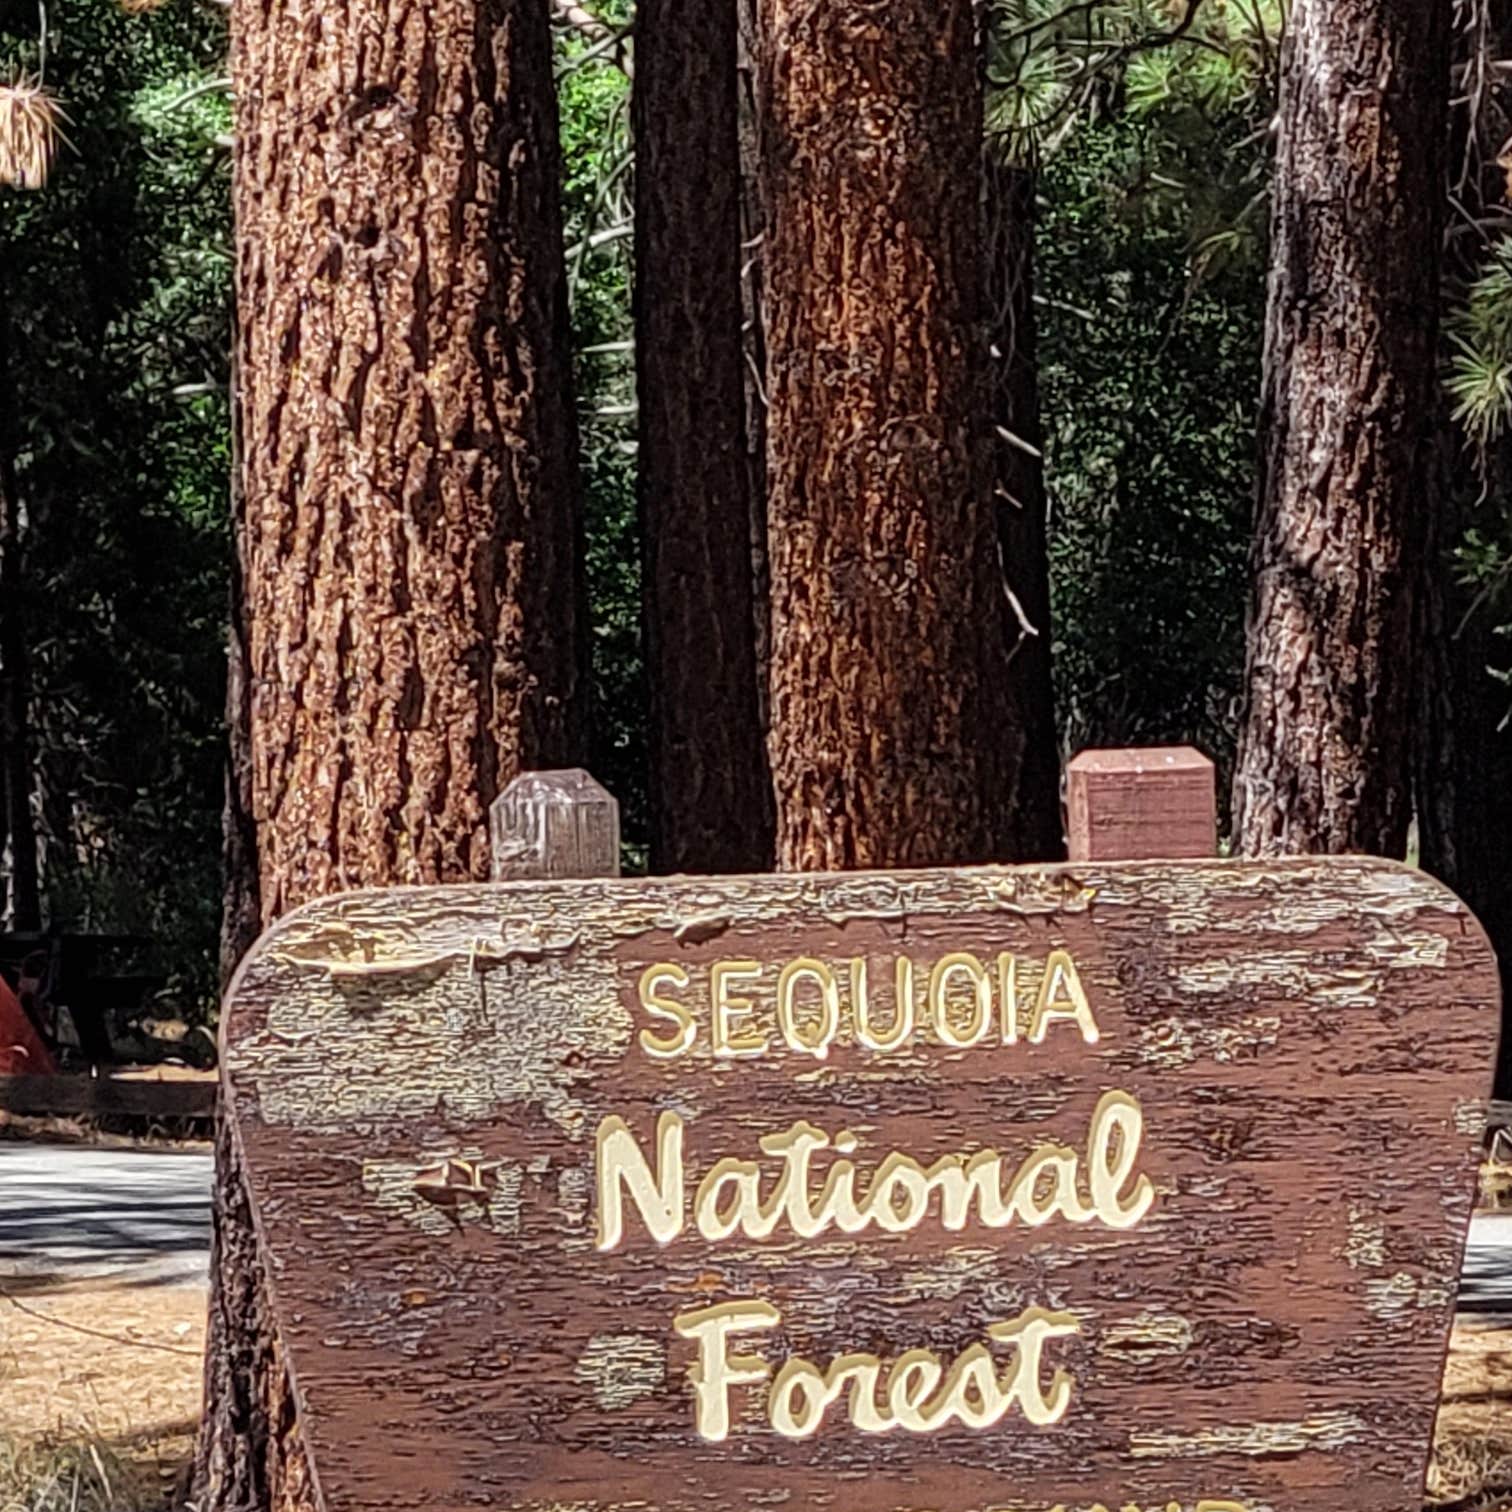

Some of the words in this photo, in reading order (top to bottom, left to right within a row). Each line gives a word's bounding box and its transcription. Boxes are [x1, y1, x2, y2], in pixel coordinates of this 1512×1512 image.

[639, 951, 1098, 1058] SEQUOIA
[598, 1091, 1153, 1249] National
[676, 1302, 1080, 1440] Forest
